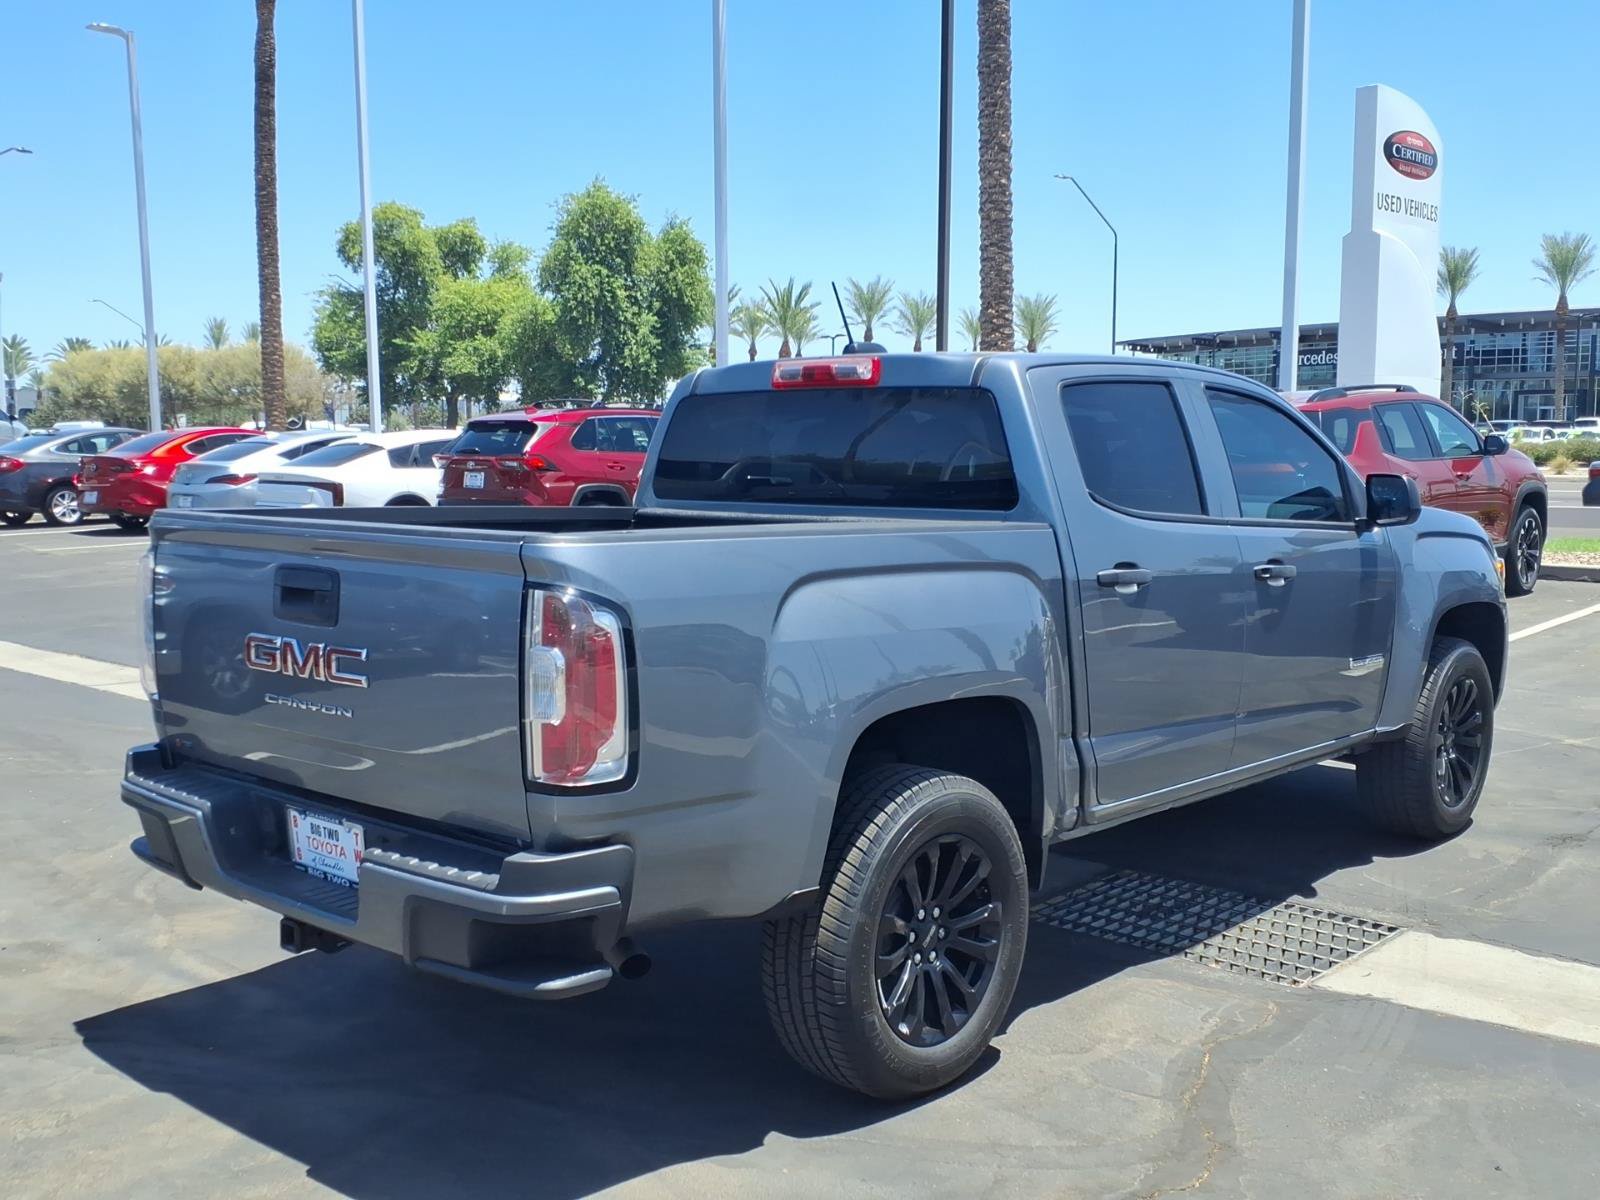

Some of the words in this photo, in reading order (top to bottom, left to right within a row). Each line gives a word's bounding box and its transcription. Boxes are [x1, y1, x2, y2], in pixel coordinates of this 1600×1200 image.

[1392, 143, 1433, 166] CERTIFIED
[1377, 192, 1402, 214] USED
[1404, 198, 1439, 223] VEHICLES
[244, 632, 369, 689] GMC
[264, 693, 353, 718] CANYON
[310, 822, 322, 838] BIG
[322, 827, 340, 842] TWO
[306, 836, 347, 859] TOYOTA
[327, 873, 350, 887] TWO
